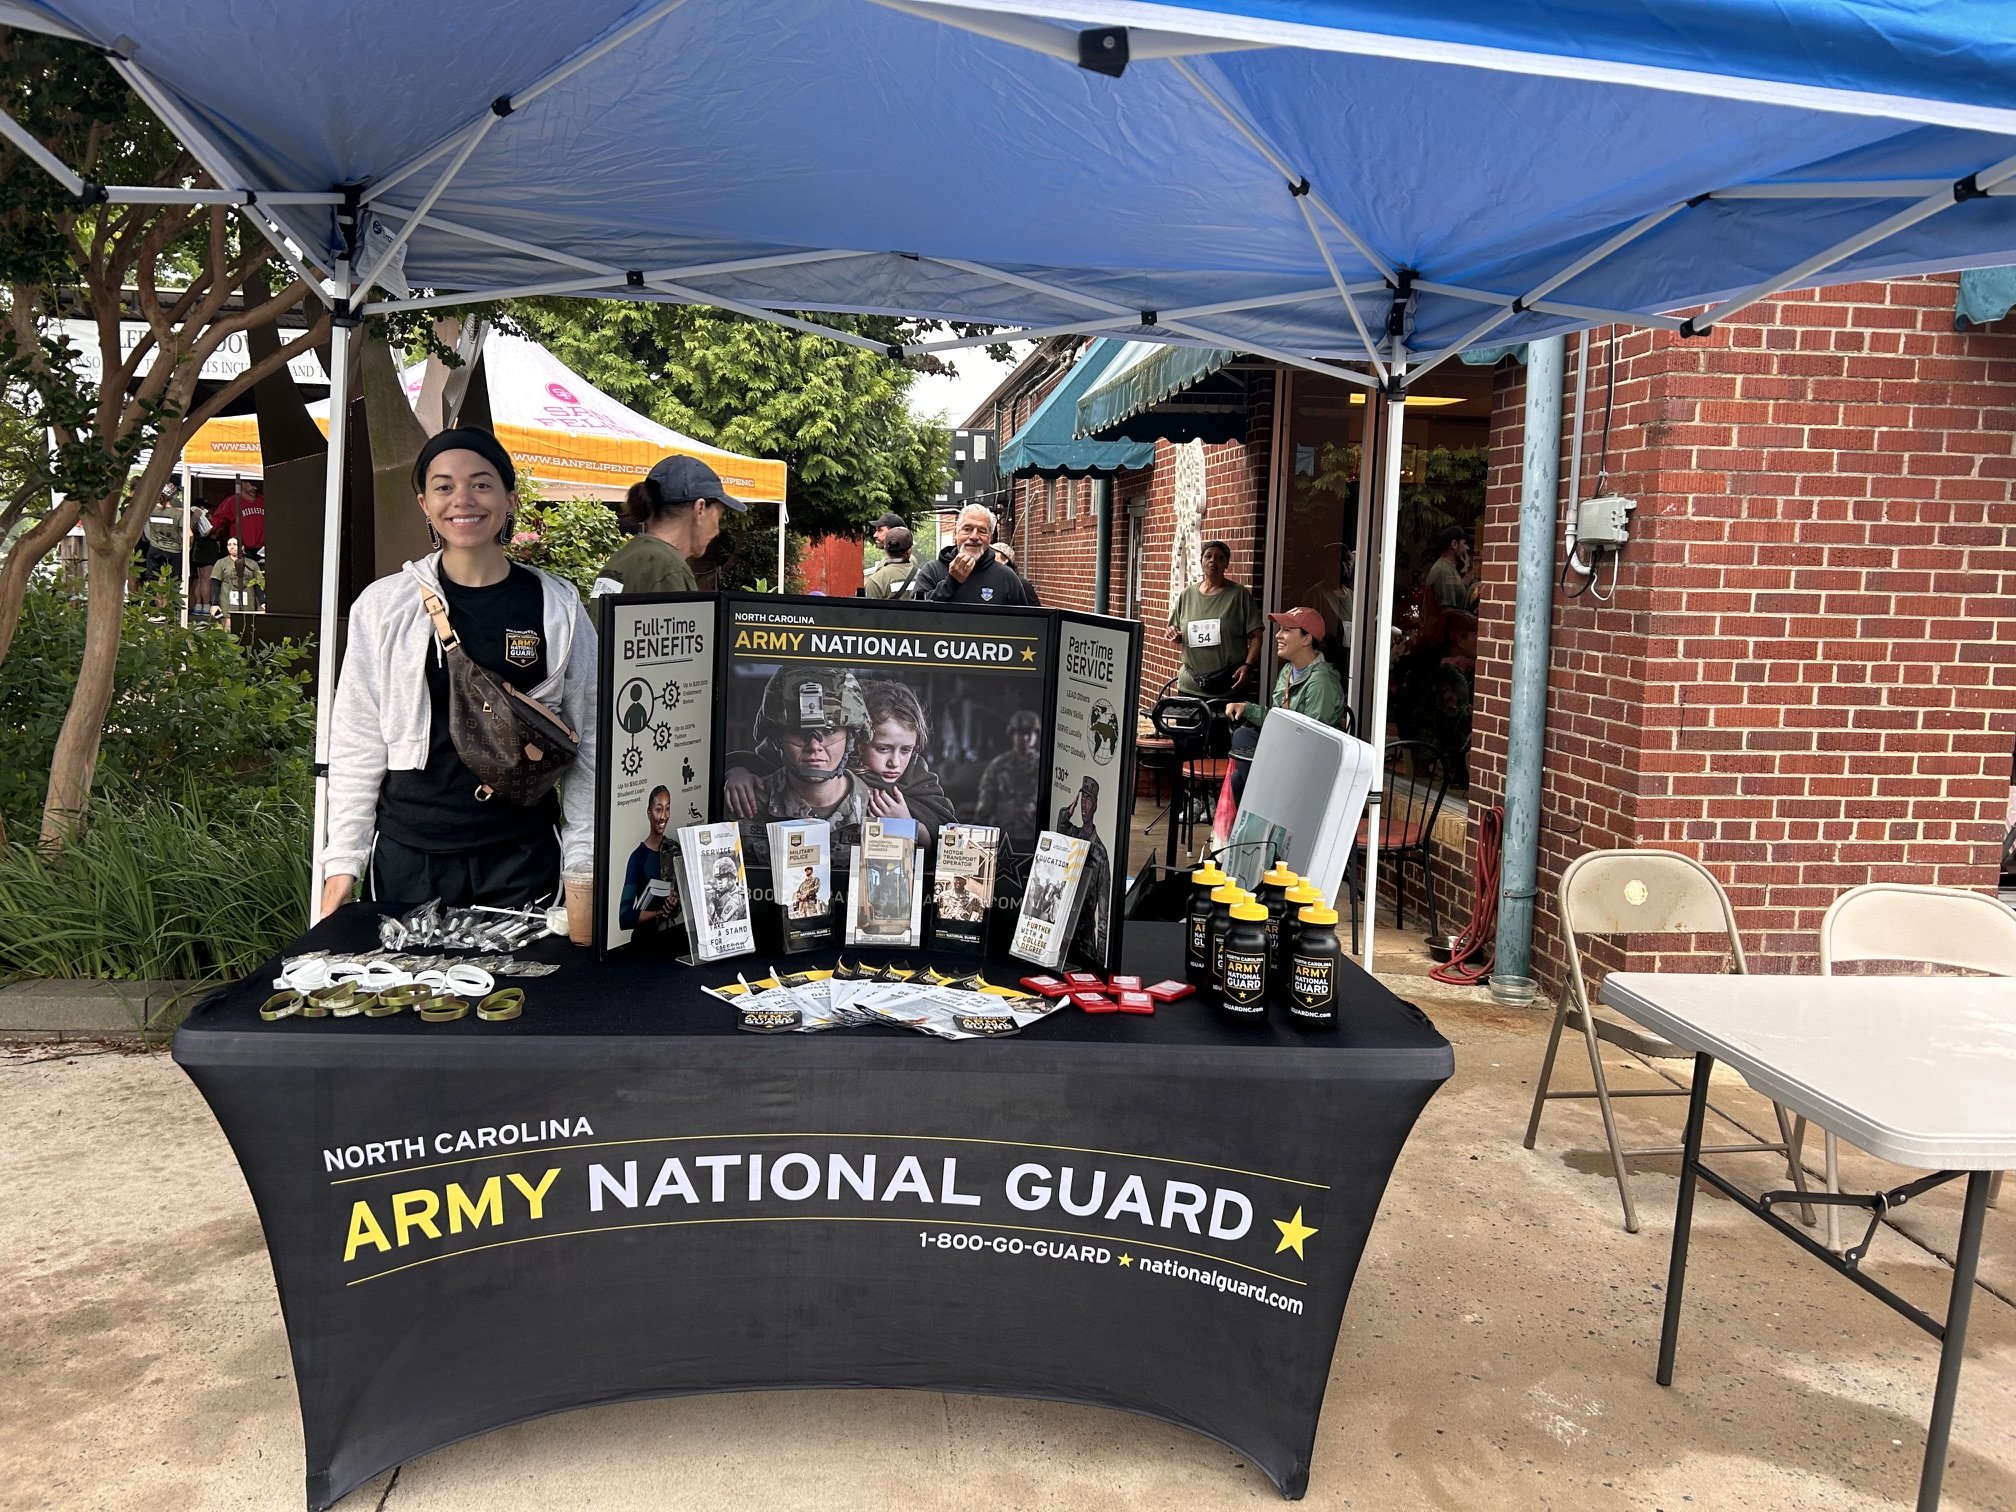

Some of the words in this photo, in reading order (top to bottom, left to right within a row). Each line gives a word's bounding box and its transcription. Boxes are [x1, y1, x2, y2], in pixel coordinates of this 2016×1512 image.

[735, 613, 766, 621] NORTH
[768, 615, 815, 624] CAROLINA
[634, 617, 696, 637] Full-Time
[1198, 633, 1210, 643] 54
[624, 634, 703, 660] BENEFITS
[734, 630, 804, 651] ARMY
[811, 634, 928, 658] NATIONAL
[933, 640, 1013, 661] GUARD
[1068, 636, 1113, 660] Part-Time
[1066, 653, 1114, 682] SERVICE
[1055, 766, 1069, 782] 130+
[701, 847, 731, 857] SERVICE
[1035, 854, 1069, 868] EDUCATION
[726, 926, 747, 935] STAND
[1021, 927, 1037, 938] WITH
[1027, 921, 1051, 934] FURTHER
[1021, 942, 1042, 954] DEGREE
[1022, 936, 1047, 949] COLLEGE
[1228, 962, 1261, 973] ARMY
[1295, 966, 1328, 978] ARMY
[1228, 971, 1260, 979] NATIONAL
[1295, 975, 1328, 985] NATIONAL
[1227, 980, 1261, 988] GUARD
[1294, 981, 1328, 994] GUARD
[323, 1136, 426, 1172] NORTH
[434, 1116, 594, 1155] CAROLINA
[343, 1167, 562, 1262] ARMY
[588, 1152, 982, 1212] NATIONAL
[1005, 1163, 1254, 1241] GUARD
[919, 1231, 1111, 1264] 1-800-GO-GUARD
[1139, 1256, 1304, 1316] nationalguard.com
